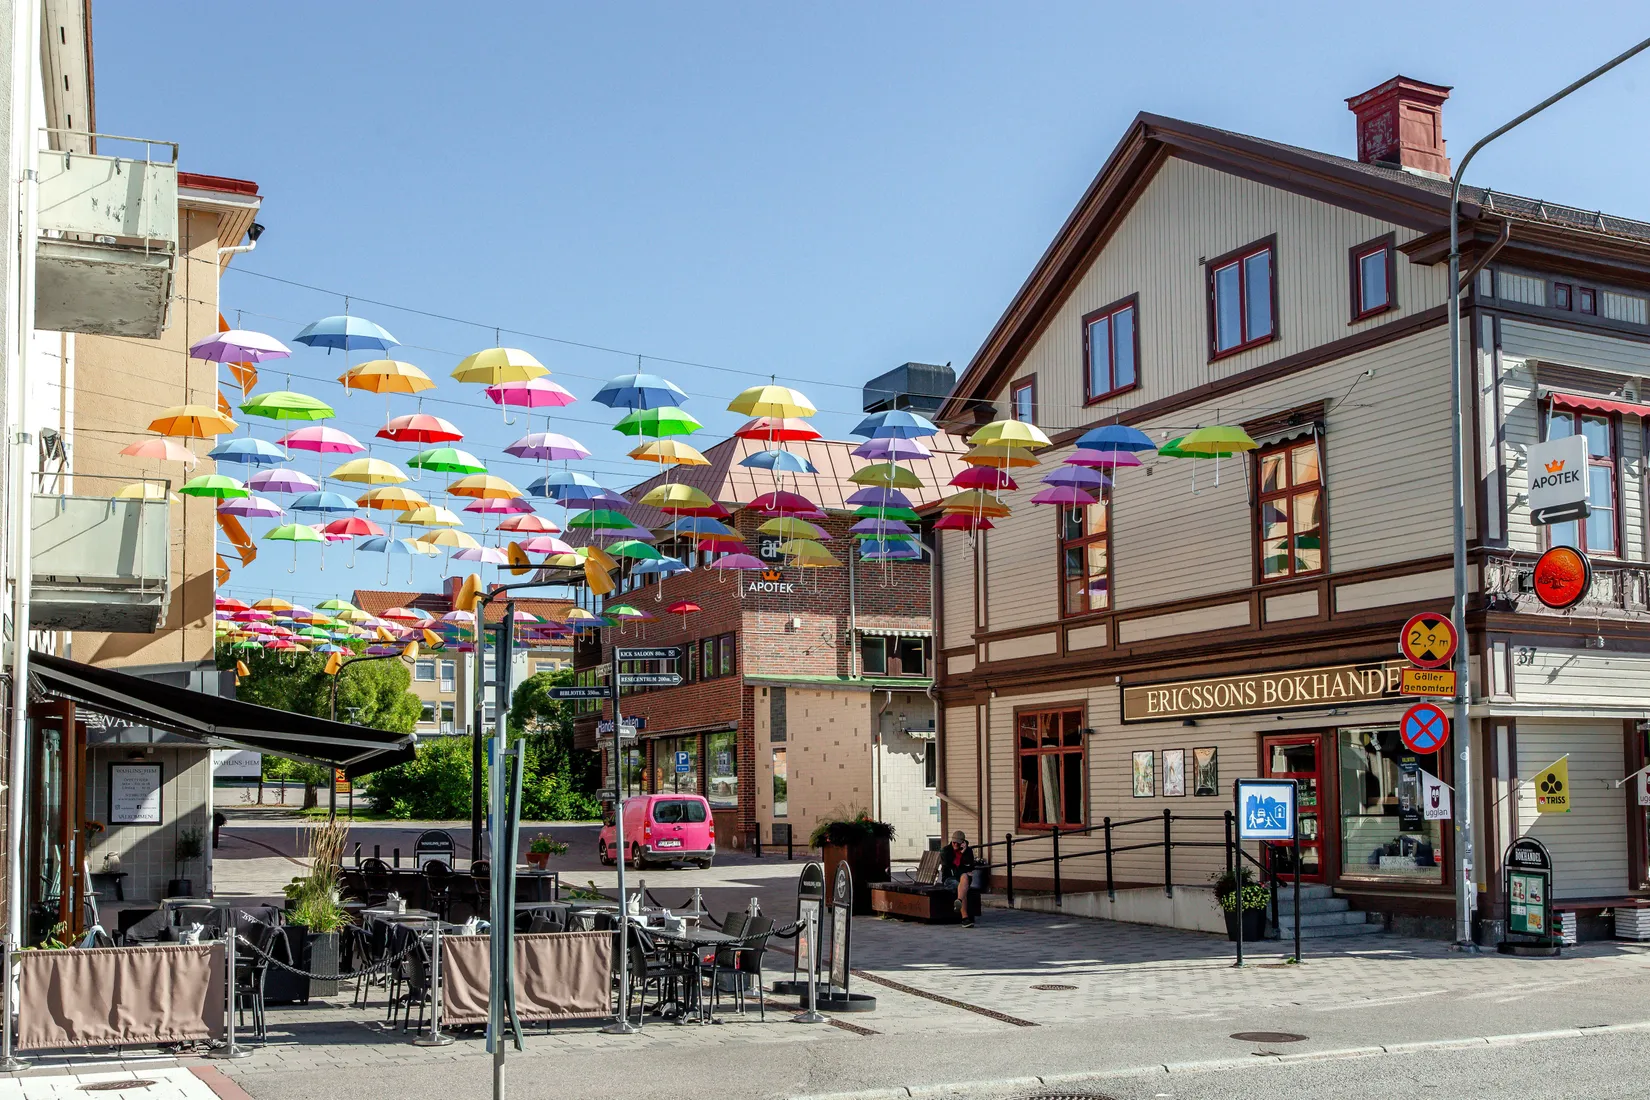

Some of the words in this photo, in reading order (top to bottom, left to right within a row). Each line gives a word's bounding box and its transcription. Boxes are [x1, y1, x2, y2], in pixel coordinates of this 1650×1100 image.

[1531, 469, 1580, 490] APOTEK
[748, 581, 794, 593] APOTEK
[1519, 647, 1537, 664] 37
[1414, 672, 1444, 681] Gäller
[1146, 681, 1257, 713] ERICSSONS
[1262, 666, 1410, 704] BOKHANDE
[1403, 684, 1454, 693] genomfart
[678, 753, 687, 764] P
[1546, 796, 1566, 804] TRISS
[1425, 809, 1448, 818] ugglan
